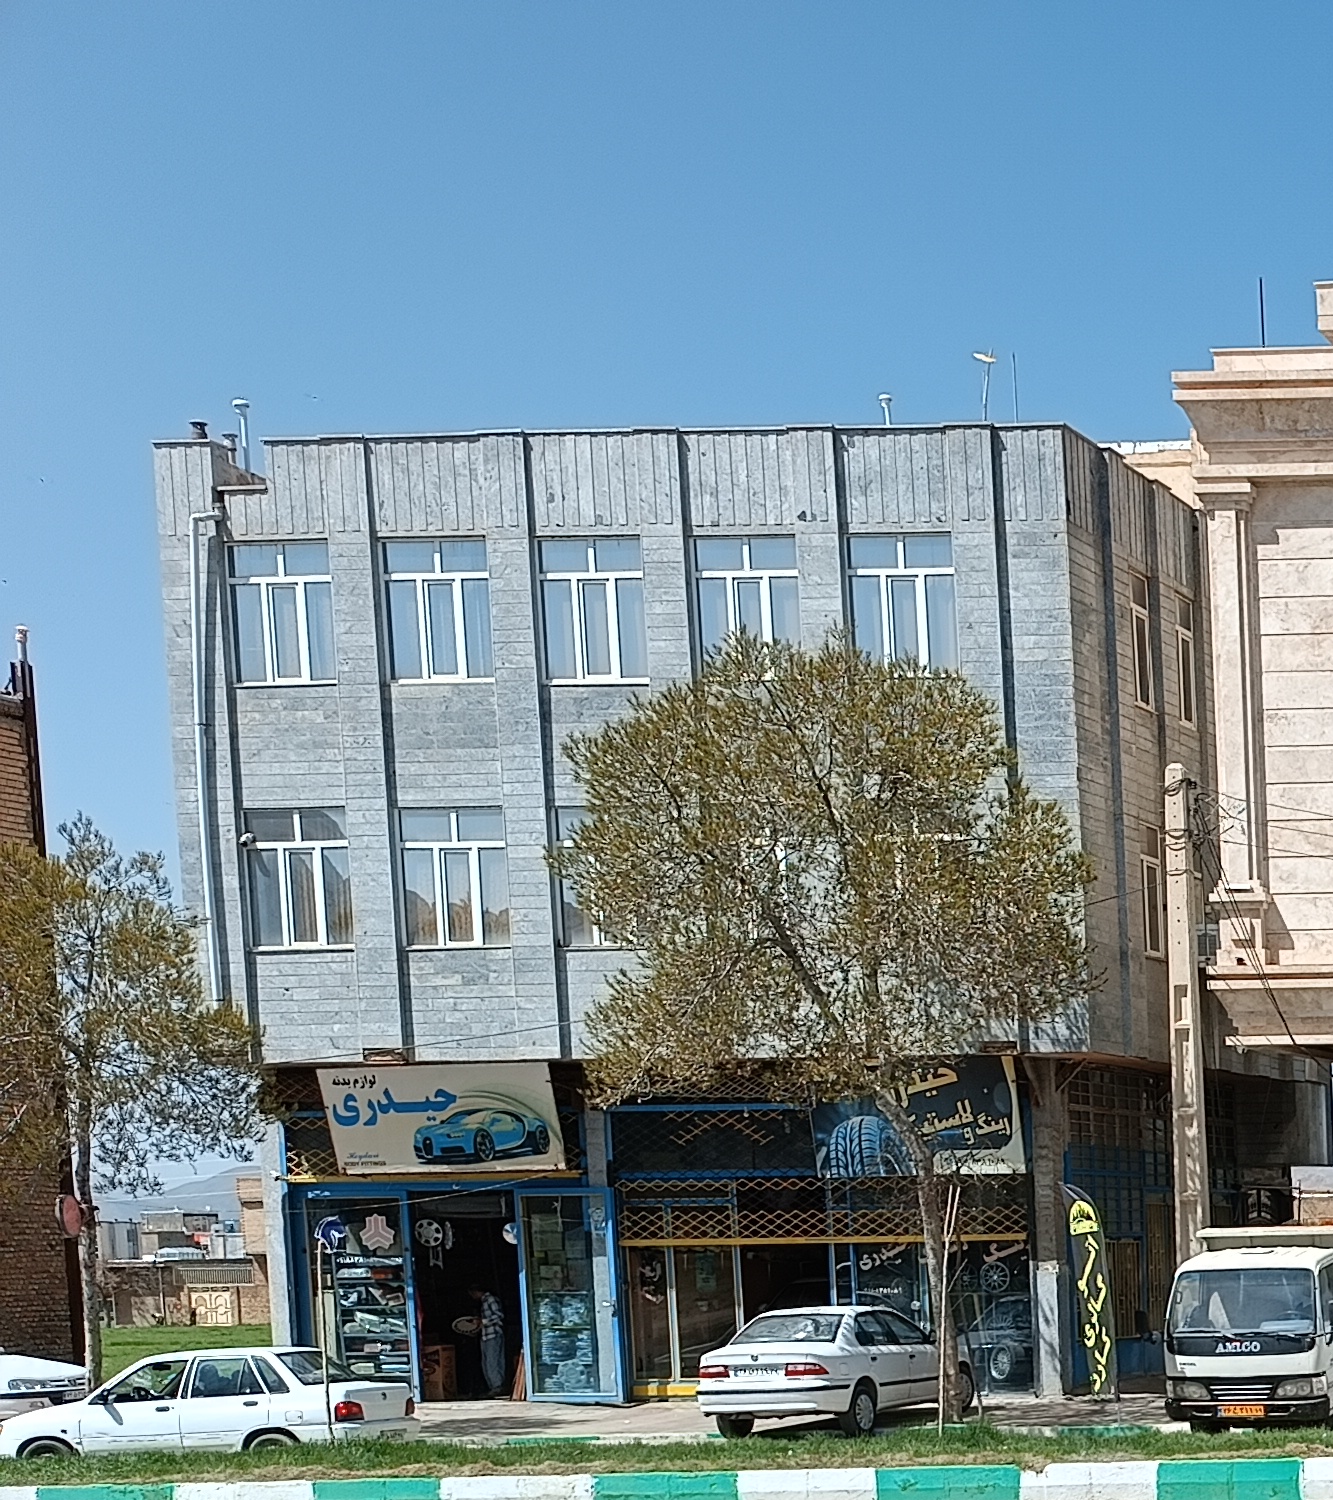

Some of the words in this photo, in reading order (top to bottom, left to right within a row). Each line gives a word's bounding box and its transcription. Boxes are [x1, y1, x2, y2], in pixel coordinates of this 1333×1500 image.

[353, 1074, 376, 1089] لوازم
[331, 1086, 458, 1127] حیدری
[907, 1099, 975, 1141] لاستی
[1215, 1341, 1261, 1353] AMICO
